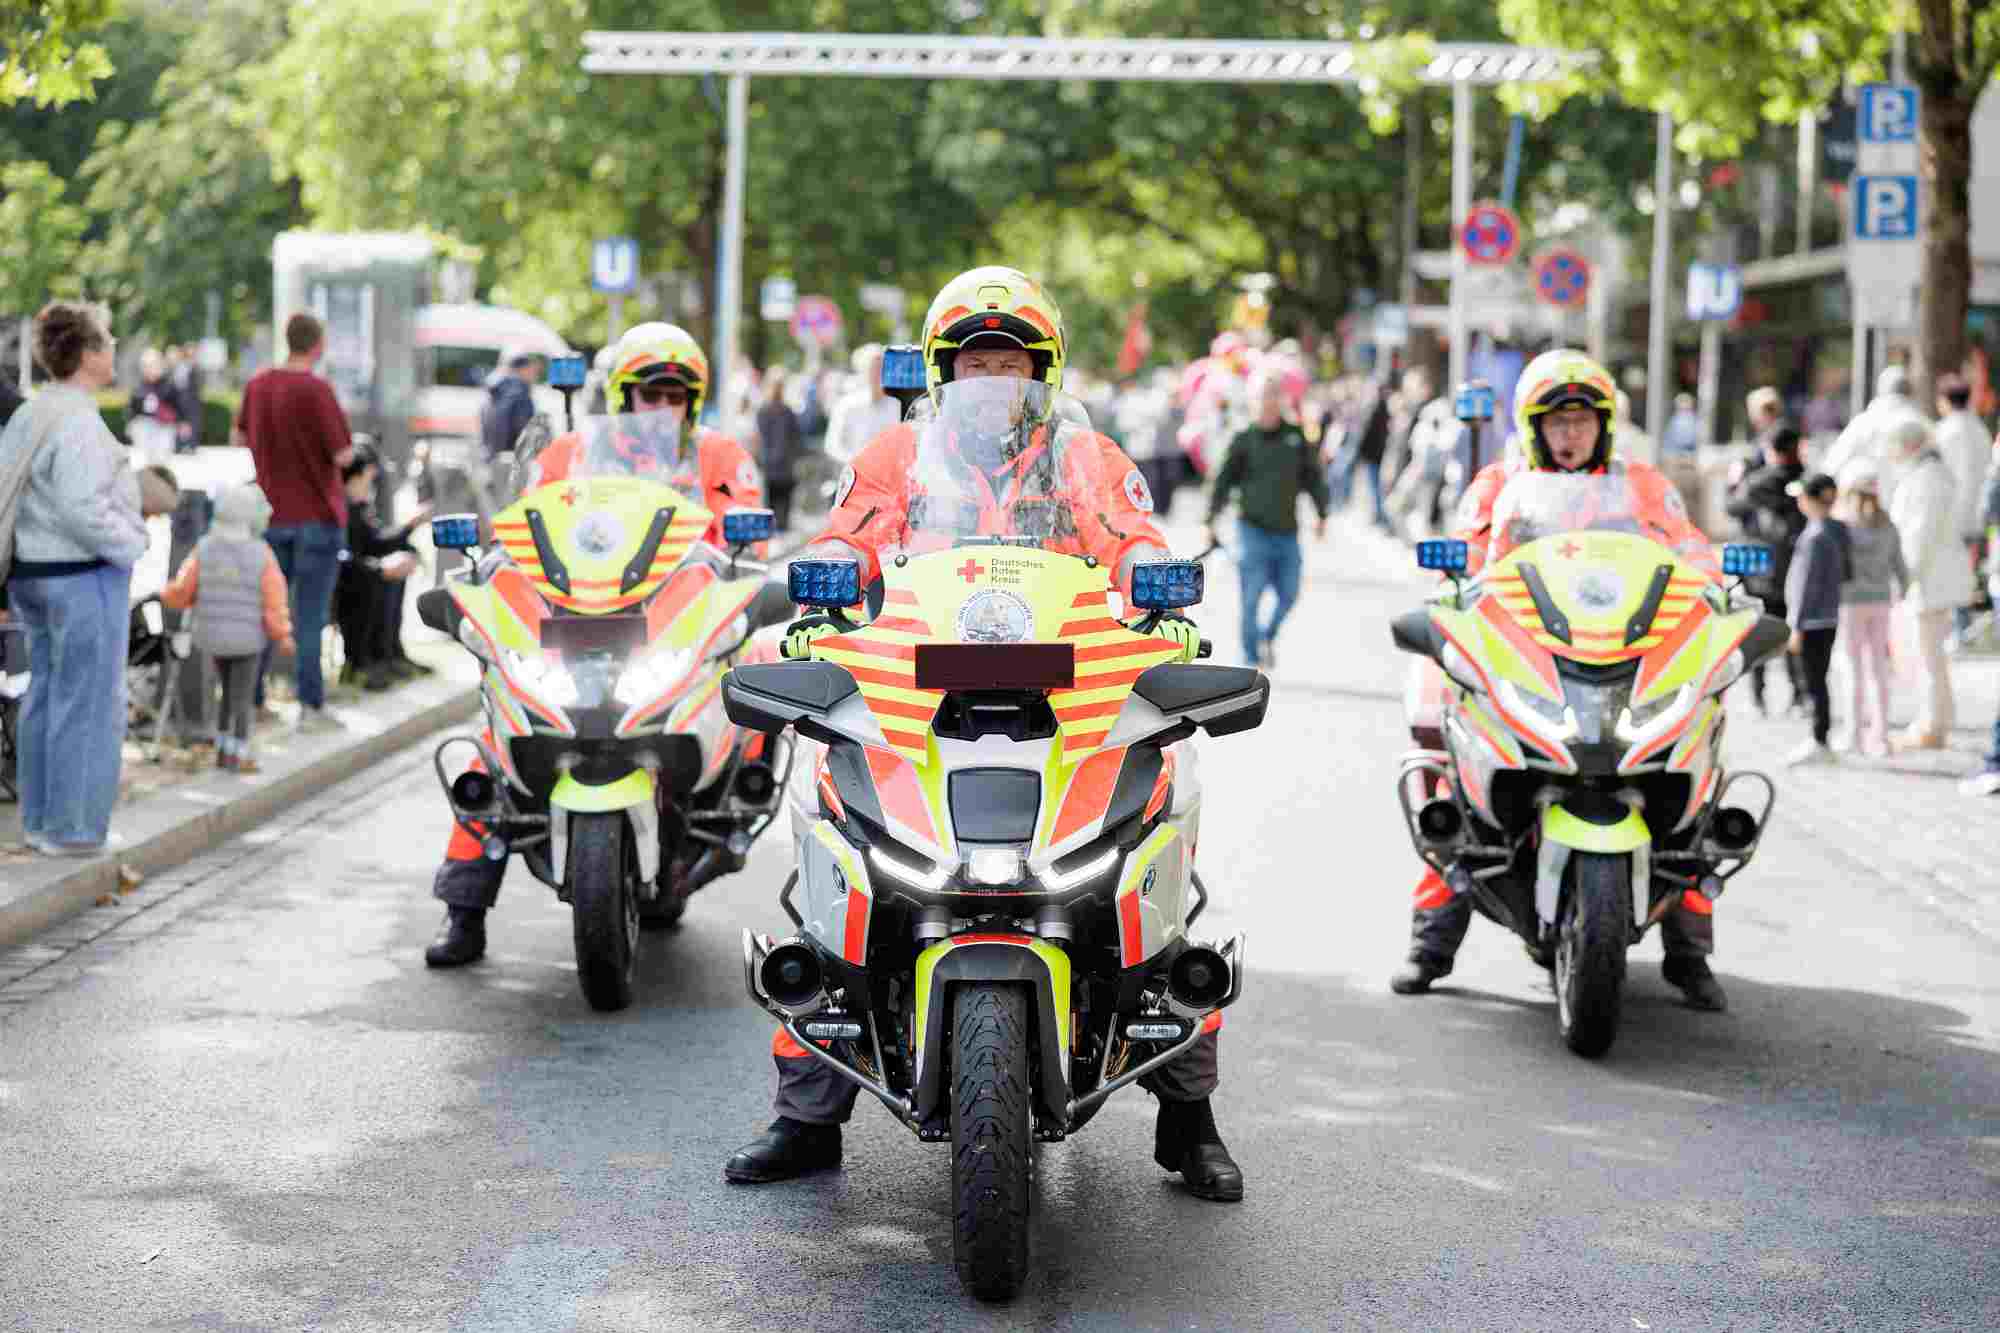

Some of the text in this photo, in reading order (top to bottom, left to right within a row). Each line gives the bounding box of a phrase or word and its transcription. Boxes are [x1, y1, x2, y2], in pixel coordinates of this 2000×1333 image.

[1871, 92, 1905, 142] P
[1868, 181, 1904, 233] P
[597, 242, 629, 286] U
[991, 558, 1045, 568] Deutsches
[991, 566, 1021, 575] Rotes
[991, 575, 1021, 584] Kreuz
